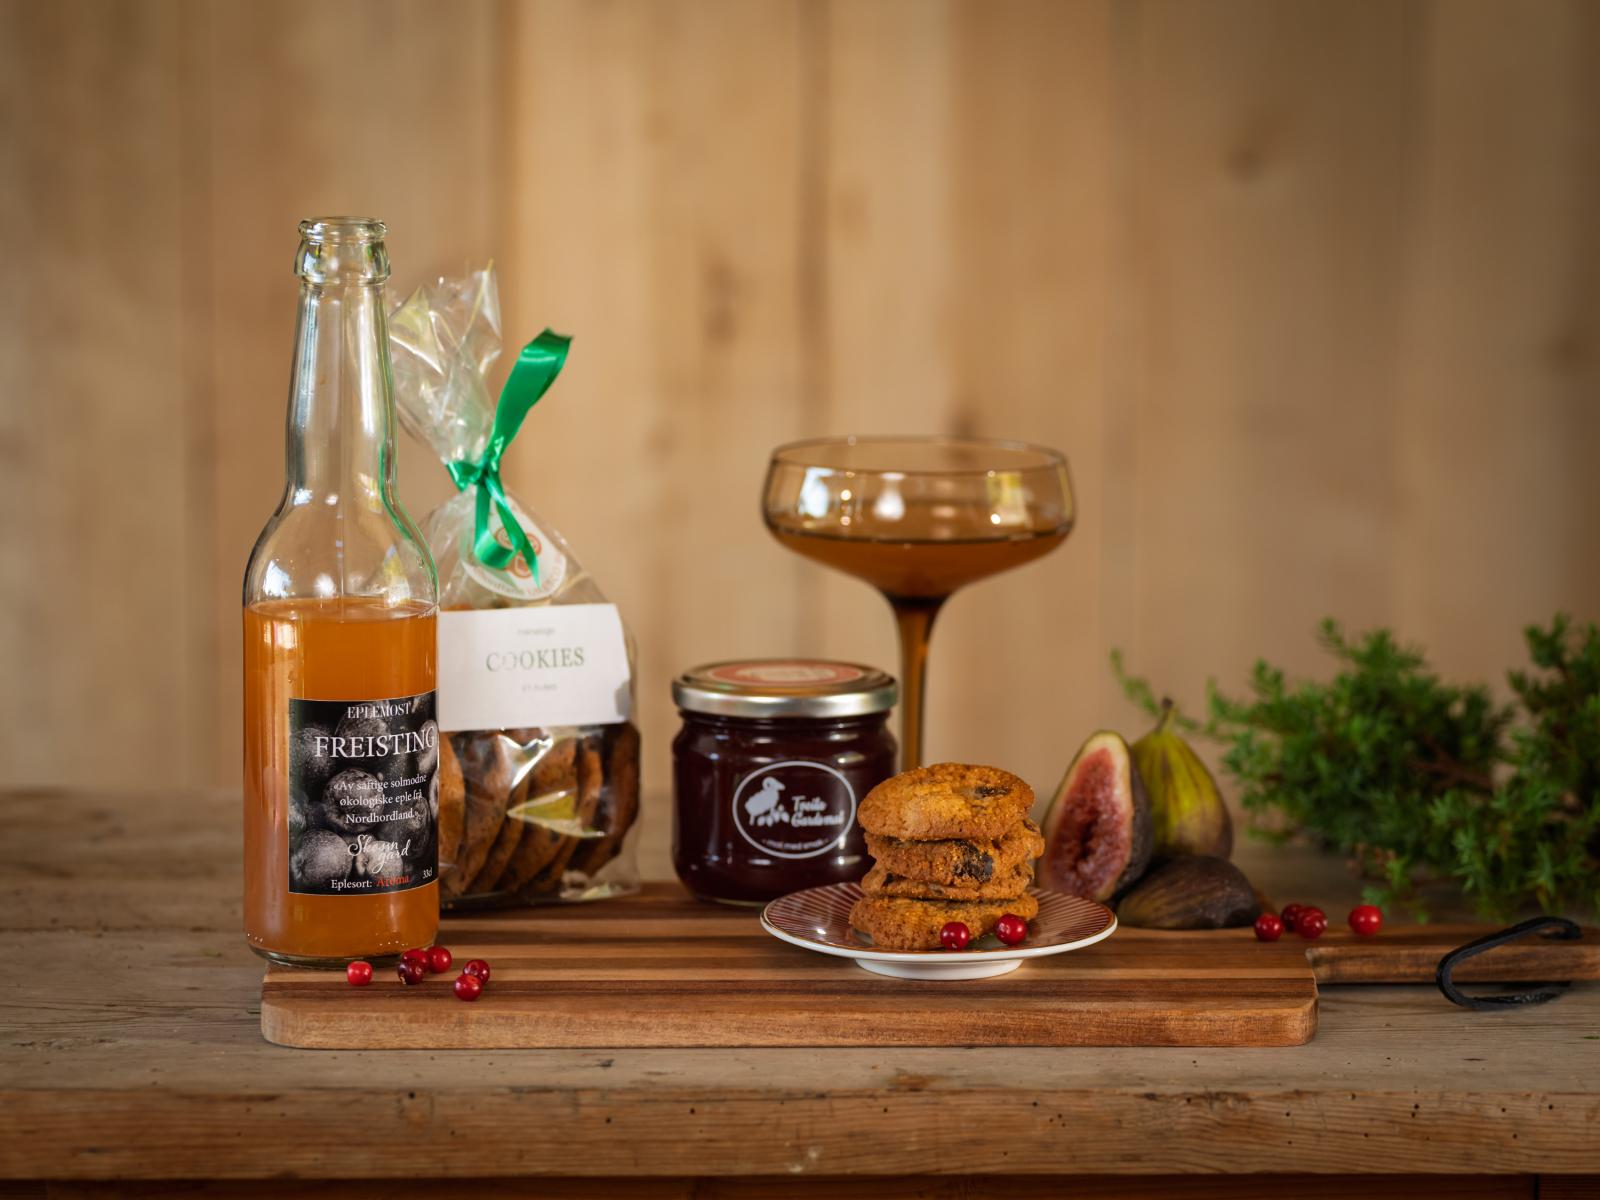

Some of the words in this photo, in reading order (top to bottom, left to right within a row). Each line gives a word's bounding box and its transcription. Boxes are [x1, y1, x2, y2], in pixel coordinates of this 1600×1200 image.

[486, 646, 585, 673] COOKIES
[347, 702, 411, 719] EPLEMOST
[314, 726, 435, 758] FREISTING
[356, 780, 389, 792] saftige
[390, 774, 427, 788] solmodne
[340, 794, 393, 808] økologiske
[395, 791, 412, 805] eple
[331, 879, 372, 891] Eplesort:
